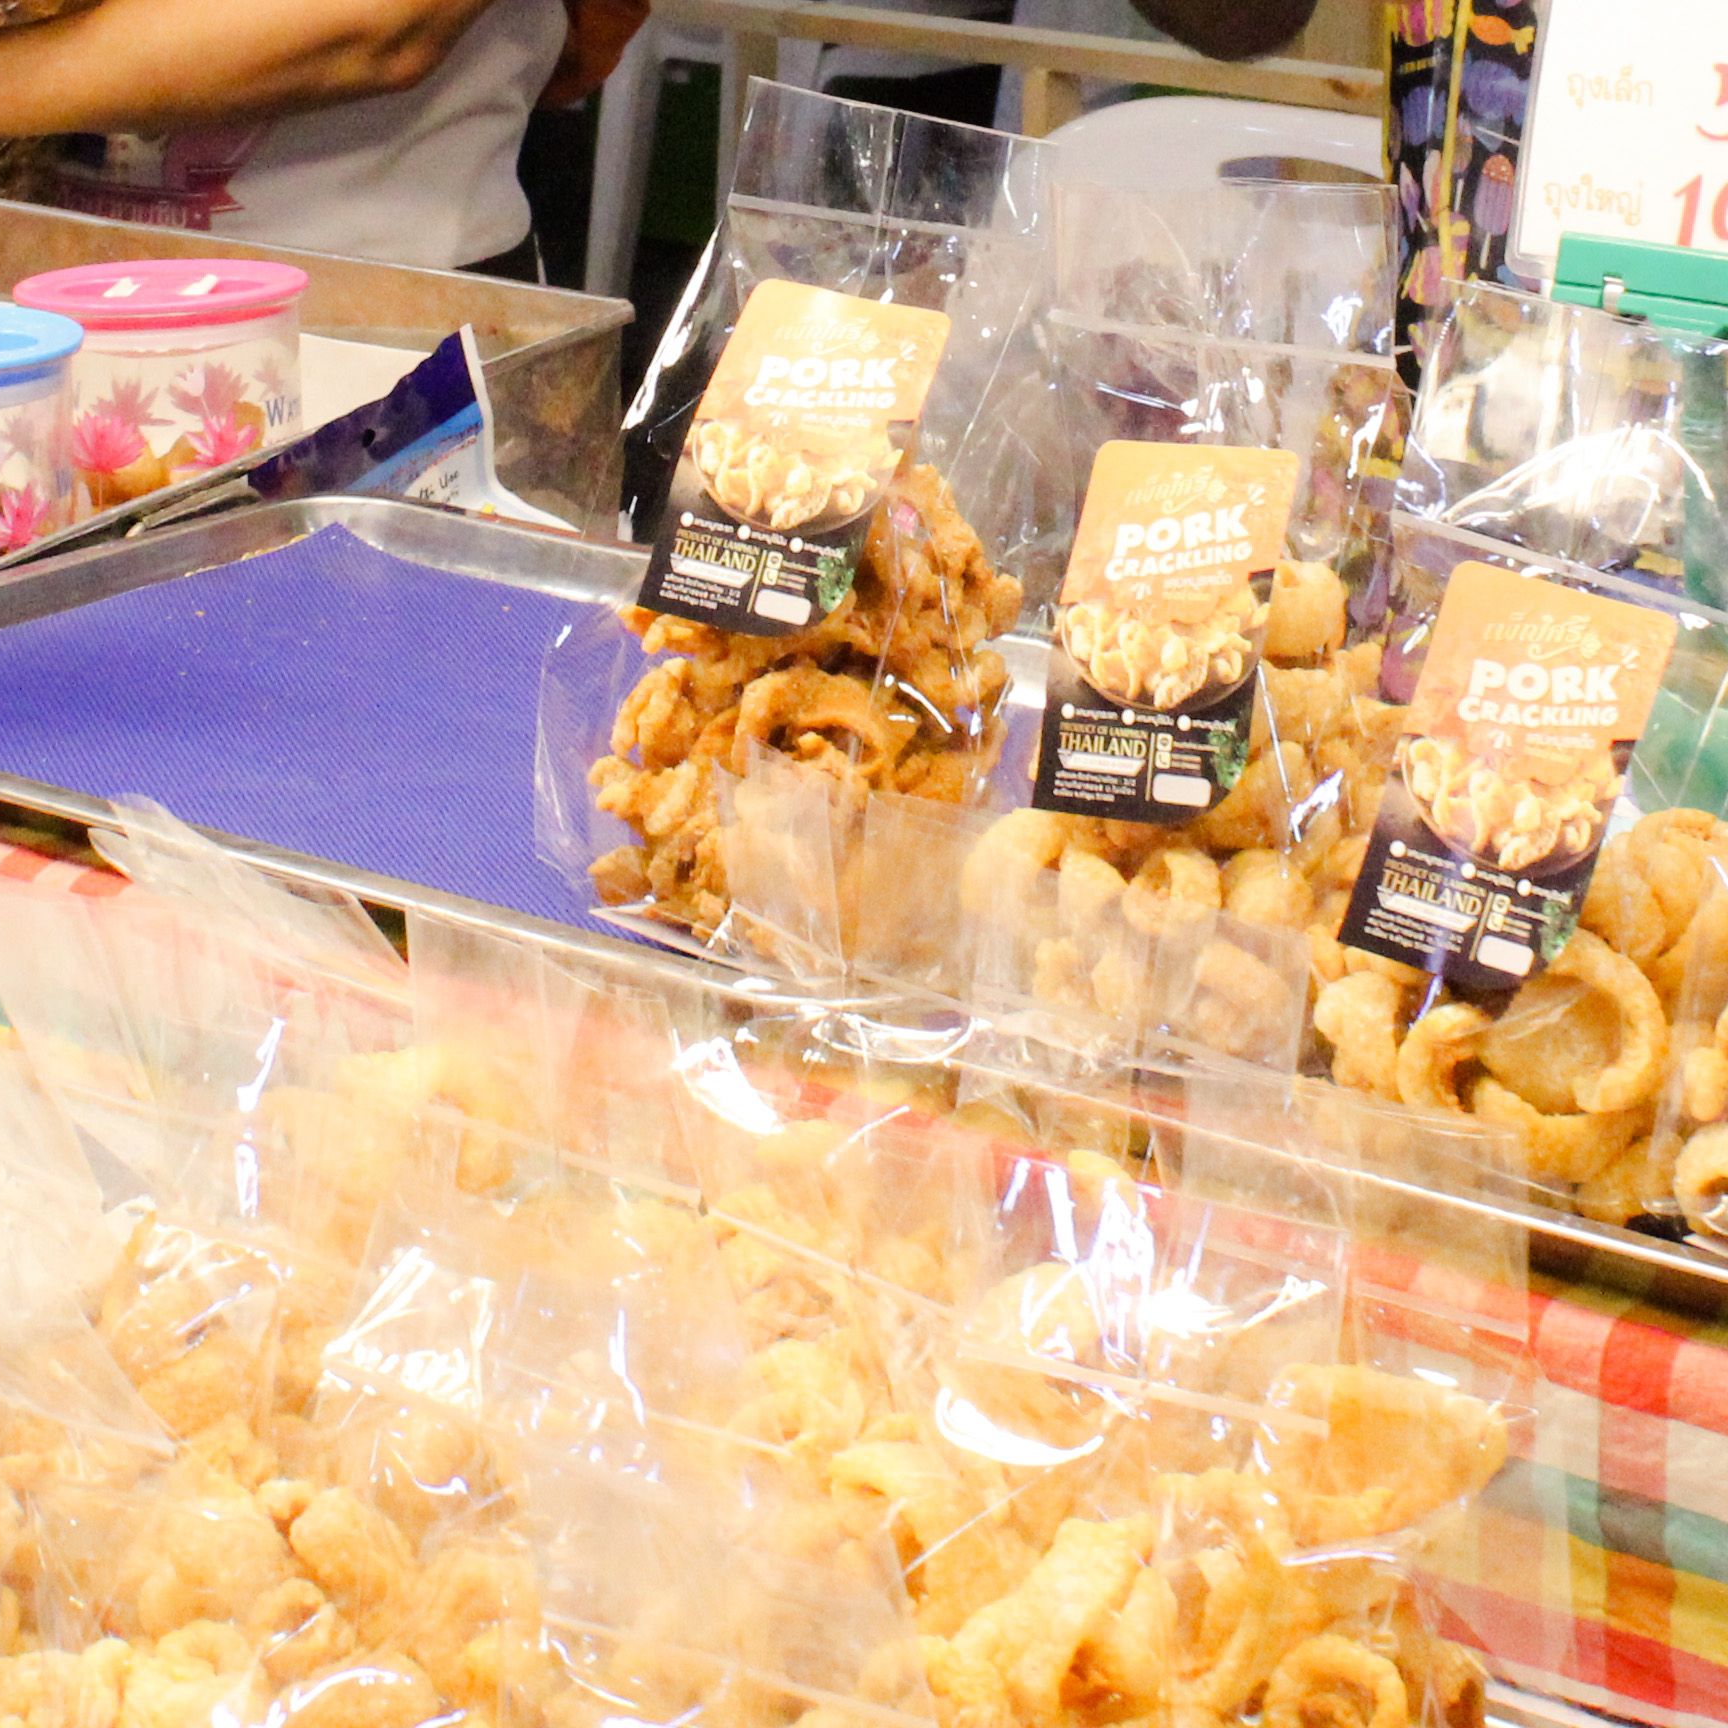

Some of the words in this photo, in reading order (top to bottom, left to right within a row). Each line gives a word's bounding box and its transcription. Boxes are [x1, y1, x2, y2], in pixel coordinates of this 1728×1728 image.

[756, 355, 898, 389] PORK
[743, 383, 896, 410] CRACKLING
[1113, 502, 1250, 558] PORK
[674, 537, 758, 574] THAILAND
[1104, 541, 1253, 582] CRACKLING
[1469, 658, 1620, 704] PORK
[1458, 695, 1619, 728] CRACKLING
[1059, 730, 1147, 759] THAILAND
[1381, 869, 1483, 917] THAILAND
